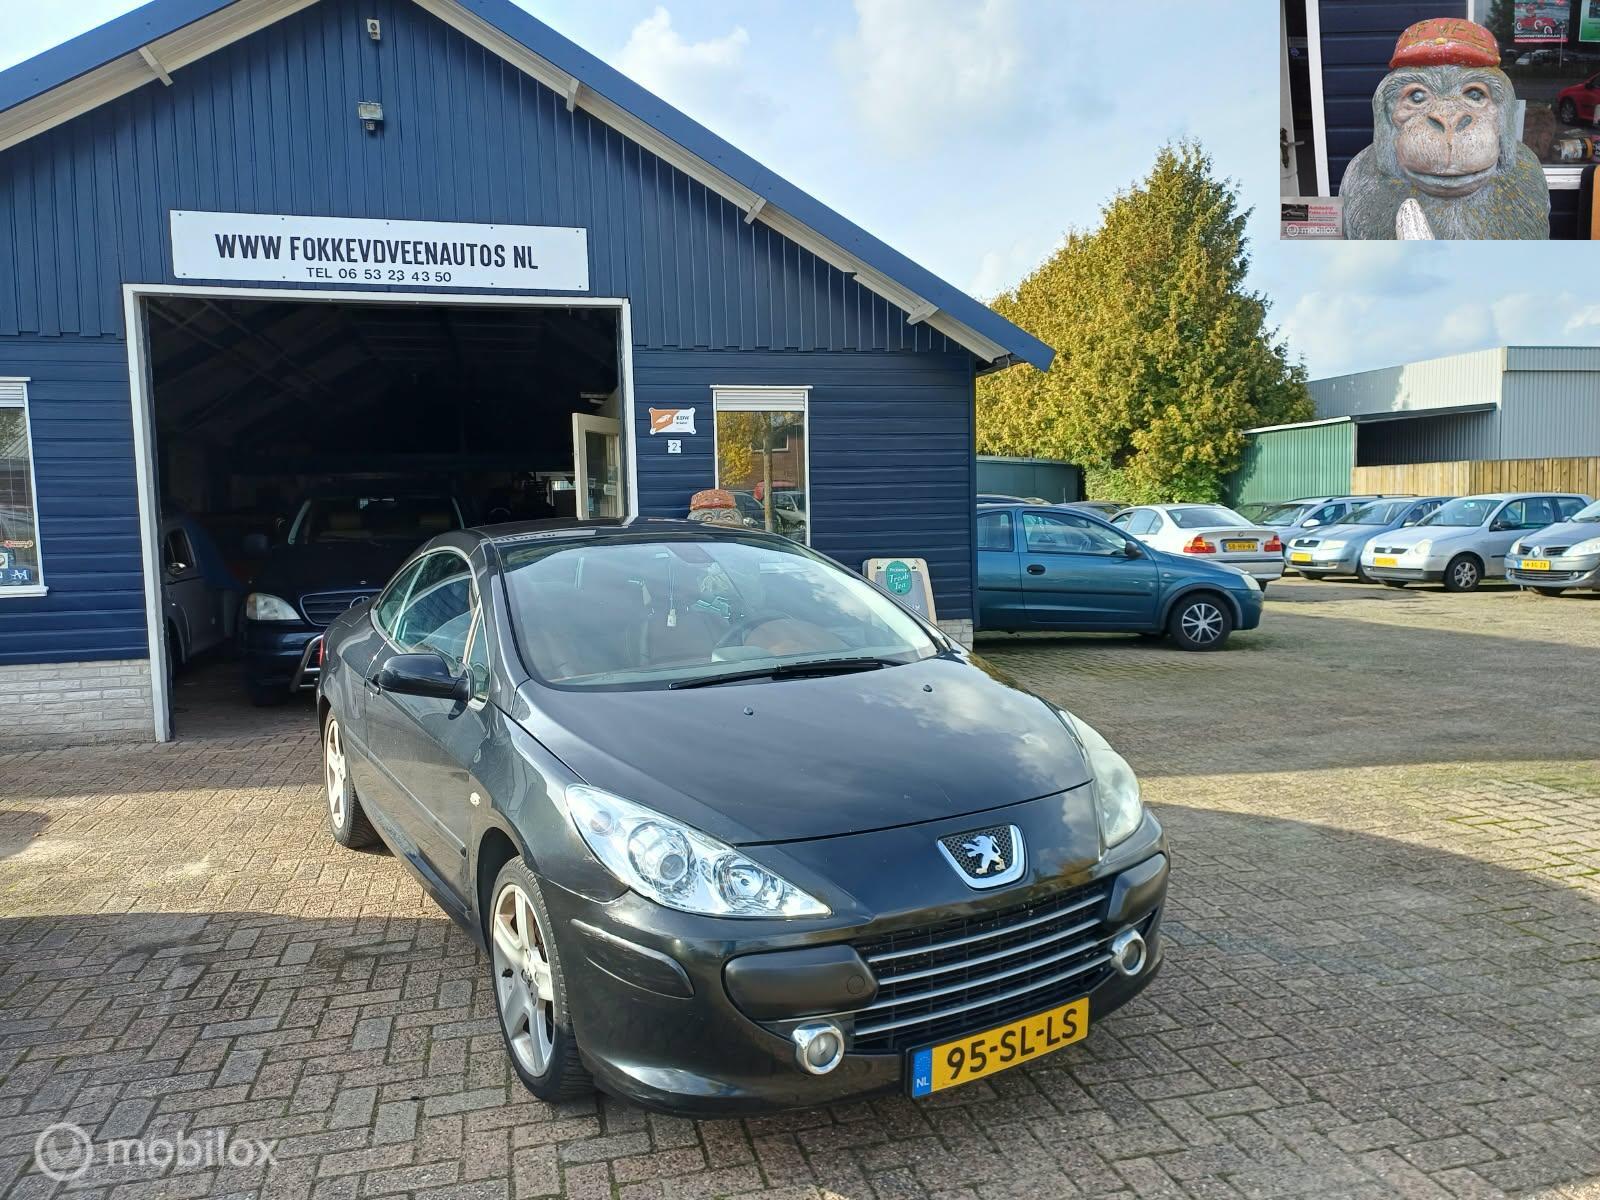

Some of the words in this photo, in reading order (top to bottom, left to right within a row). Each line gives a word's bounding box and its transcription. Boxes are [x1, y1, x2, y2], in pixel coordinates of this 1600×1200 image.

[214, 233, 282, 260] WWW
[289, 236, 506, 268] FOKKEVDVEENAUTOS
[513, 245, 538, 270] NL
[306, 267, 333, 279] TEL
[338, 268, 357, 279] 06
[364, 269, 382, 280] 53
[388, 269, 405, 282] 23
[411, 271, 430, 282] 43
[434, 271, 452, 283] 50
[671, 442, 678, 452] 2
[946, 1007, 1078, 1080] 95-SL-LS
[916, 1076, 930, 1088] NL
